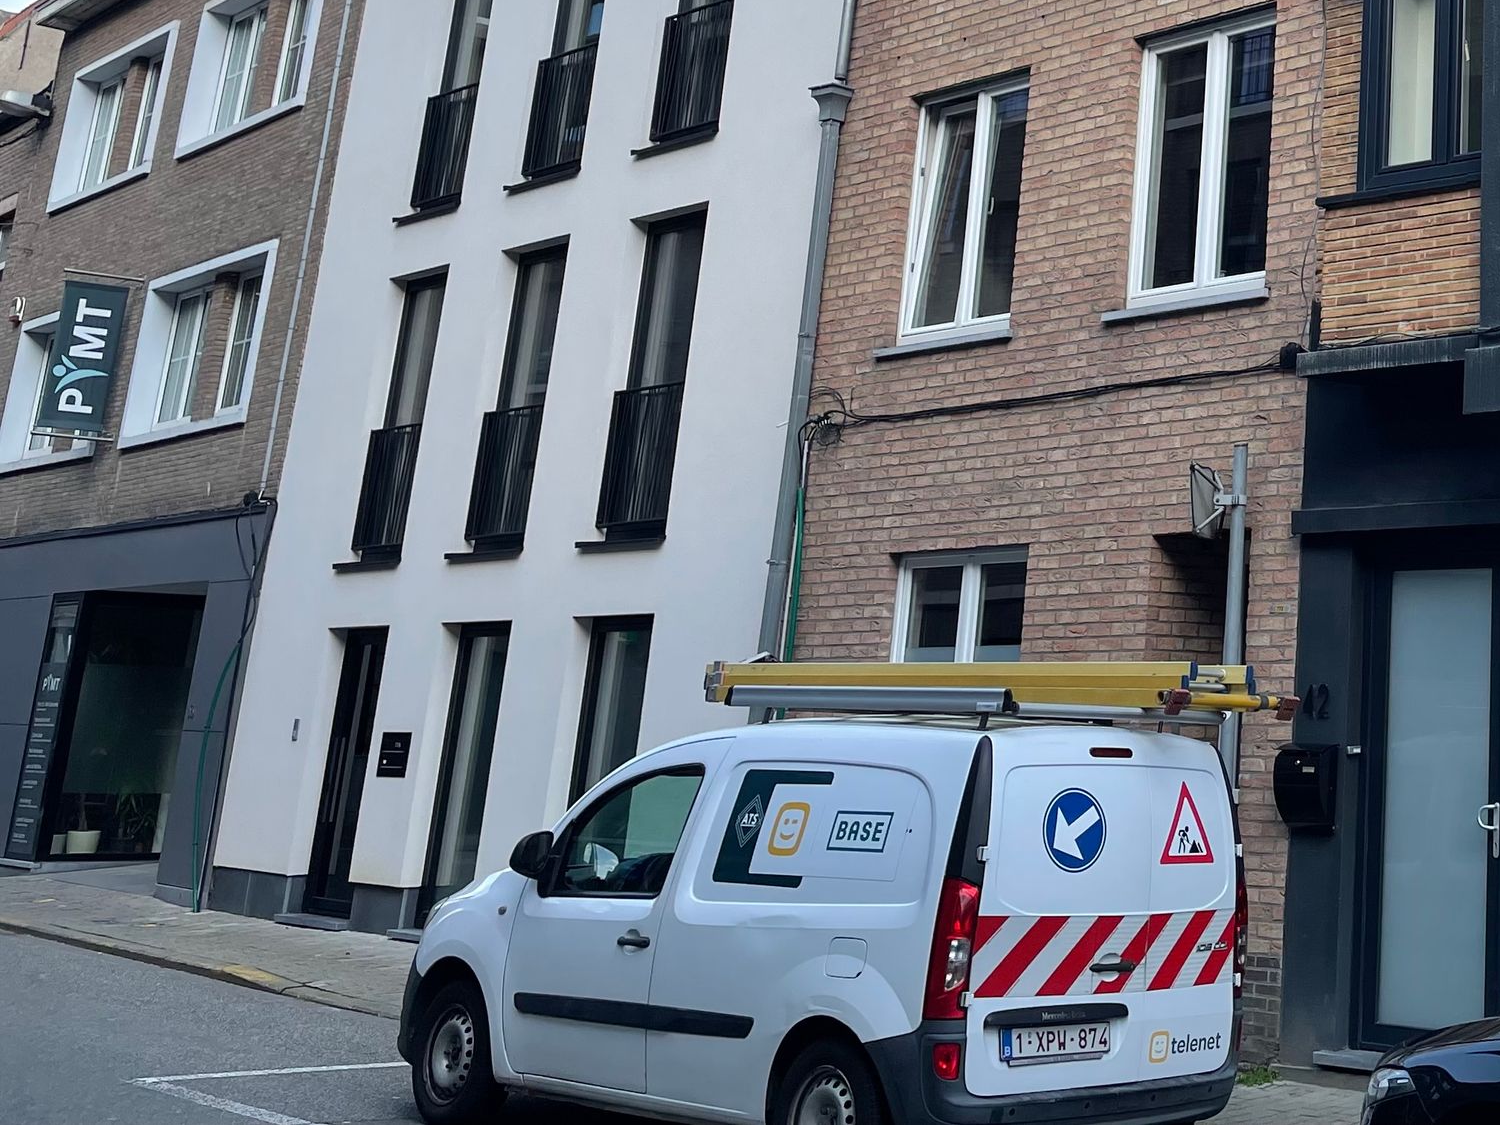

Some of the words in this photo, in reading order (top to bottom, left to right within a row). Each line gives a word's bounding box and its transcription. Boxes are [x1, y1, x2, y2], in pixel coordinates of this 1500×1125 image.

[53, 298, 112, 414] PYMT
[1303, 683, 1329, 718] 42
[740, 813, 759, 825] ATS
[835, 821, 884, 842] BASE
[1004, 1046, 1011, 1055] B
[1171, 1032, 1221, 1054] telenet
